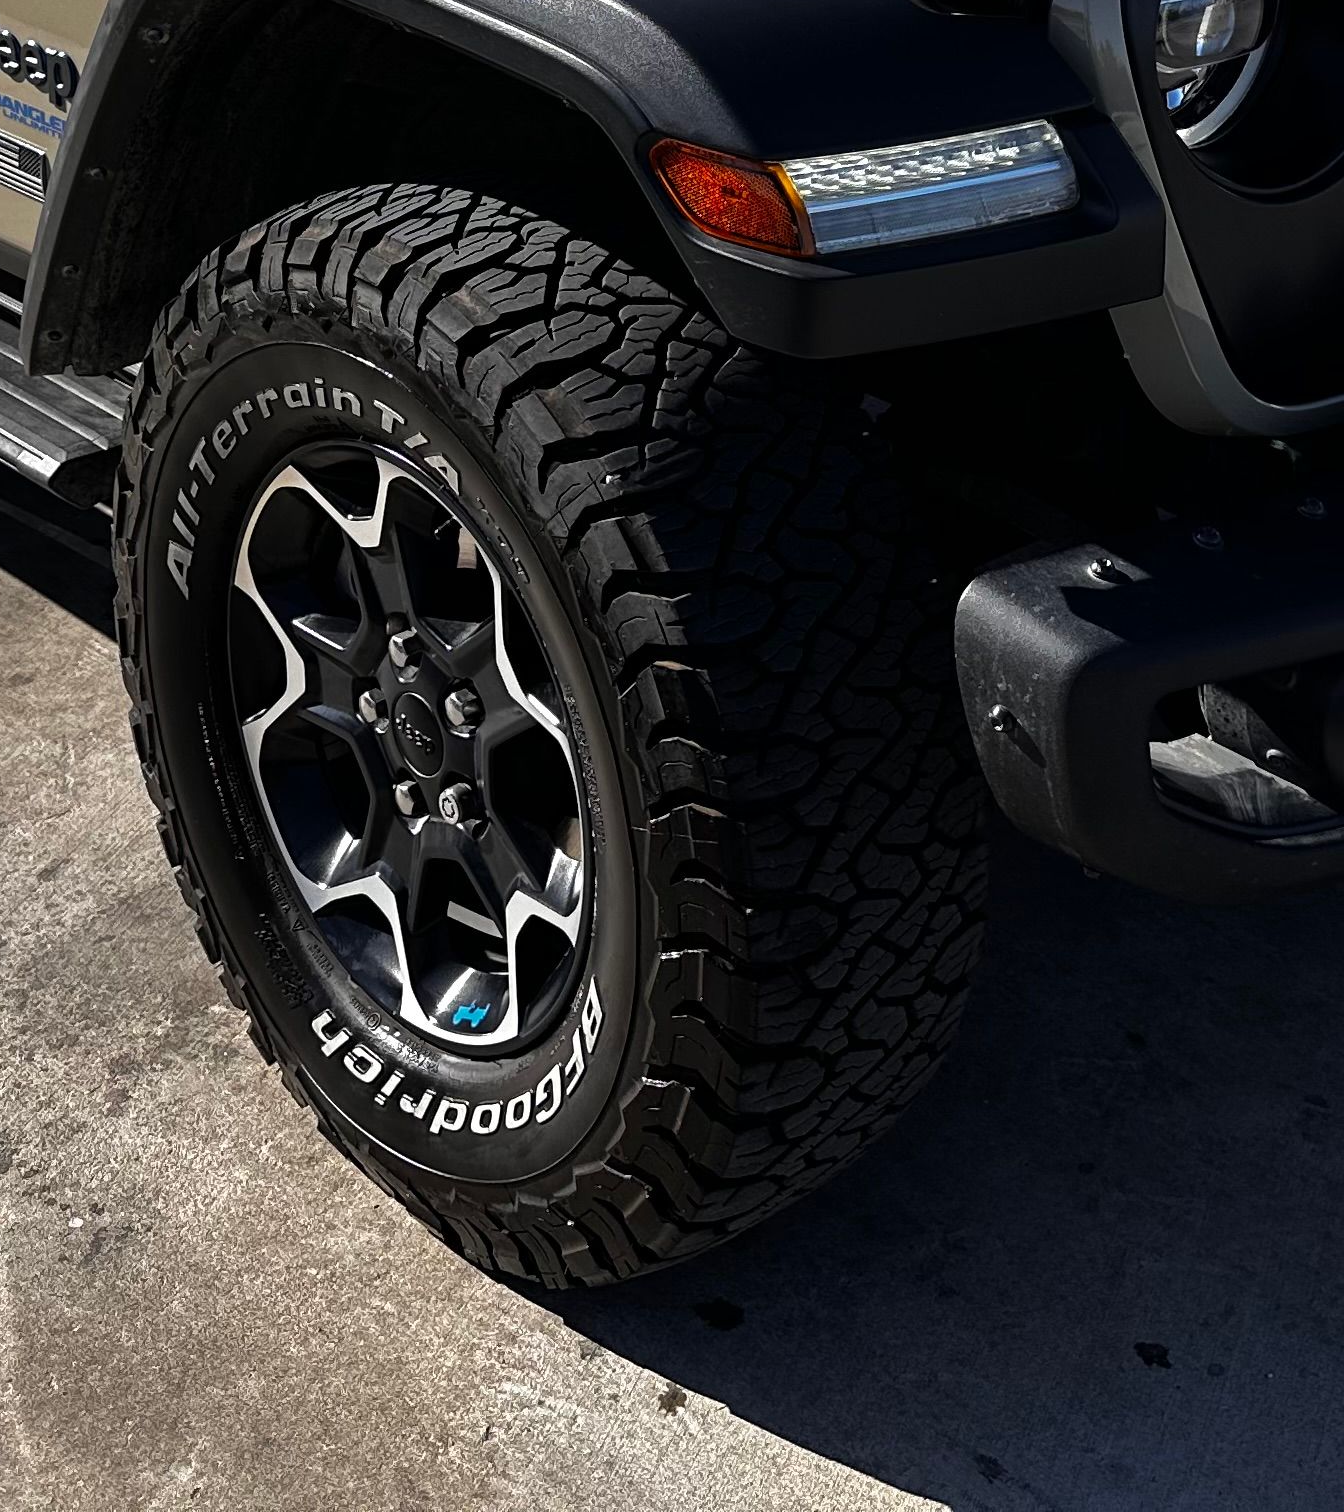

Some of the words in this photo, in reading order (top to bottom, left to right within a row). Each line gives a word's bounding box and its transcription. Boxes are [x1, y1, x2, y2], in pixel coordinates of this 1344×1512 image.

[2, 109, 65, 139] UNLIMIT
[167, 377, 362, 601] All-Terrain
[311, 974, 604, 1136] BFGoodrich
